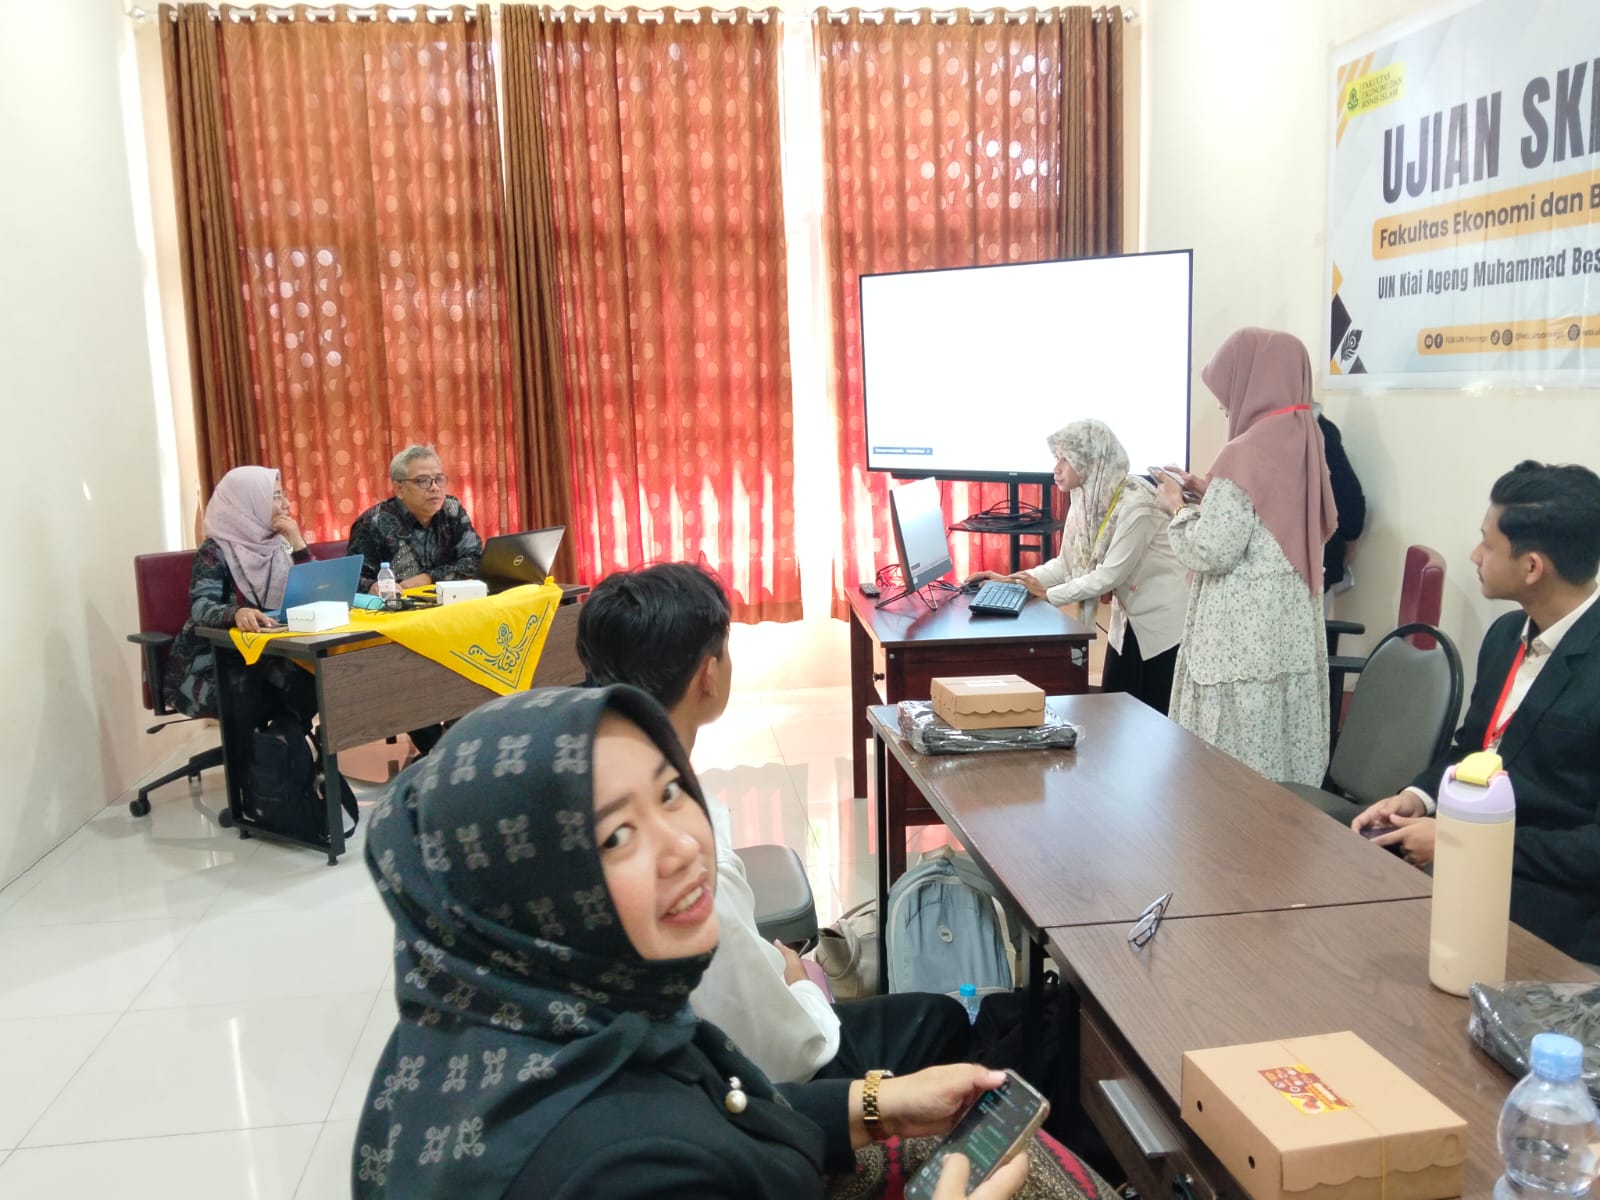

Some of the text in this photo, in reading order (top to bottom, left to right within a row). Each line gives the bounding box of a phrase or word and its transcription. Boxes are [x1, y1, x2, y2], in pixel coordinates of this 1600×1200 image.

[1383, 91, 1502, 204] UJIAN
[1380, 219, 1448, 249] Fakultas
[1453, 194, 1536, 235] Ekonomi
[1540, 191, 1583, 218] dan
[1378, 274, 1395, 300] UIN
[1400, 269, 1422, 297] Kiai
[1427, 267, 1468, 295] Ageng
[1473, 249, 1566, 287] Muhammad
